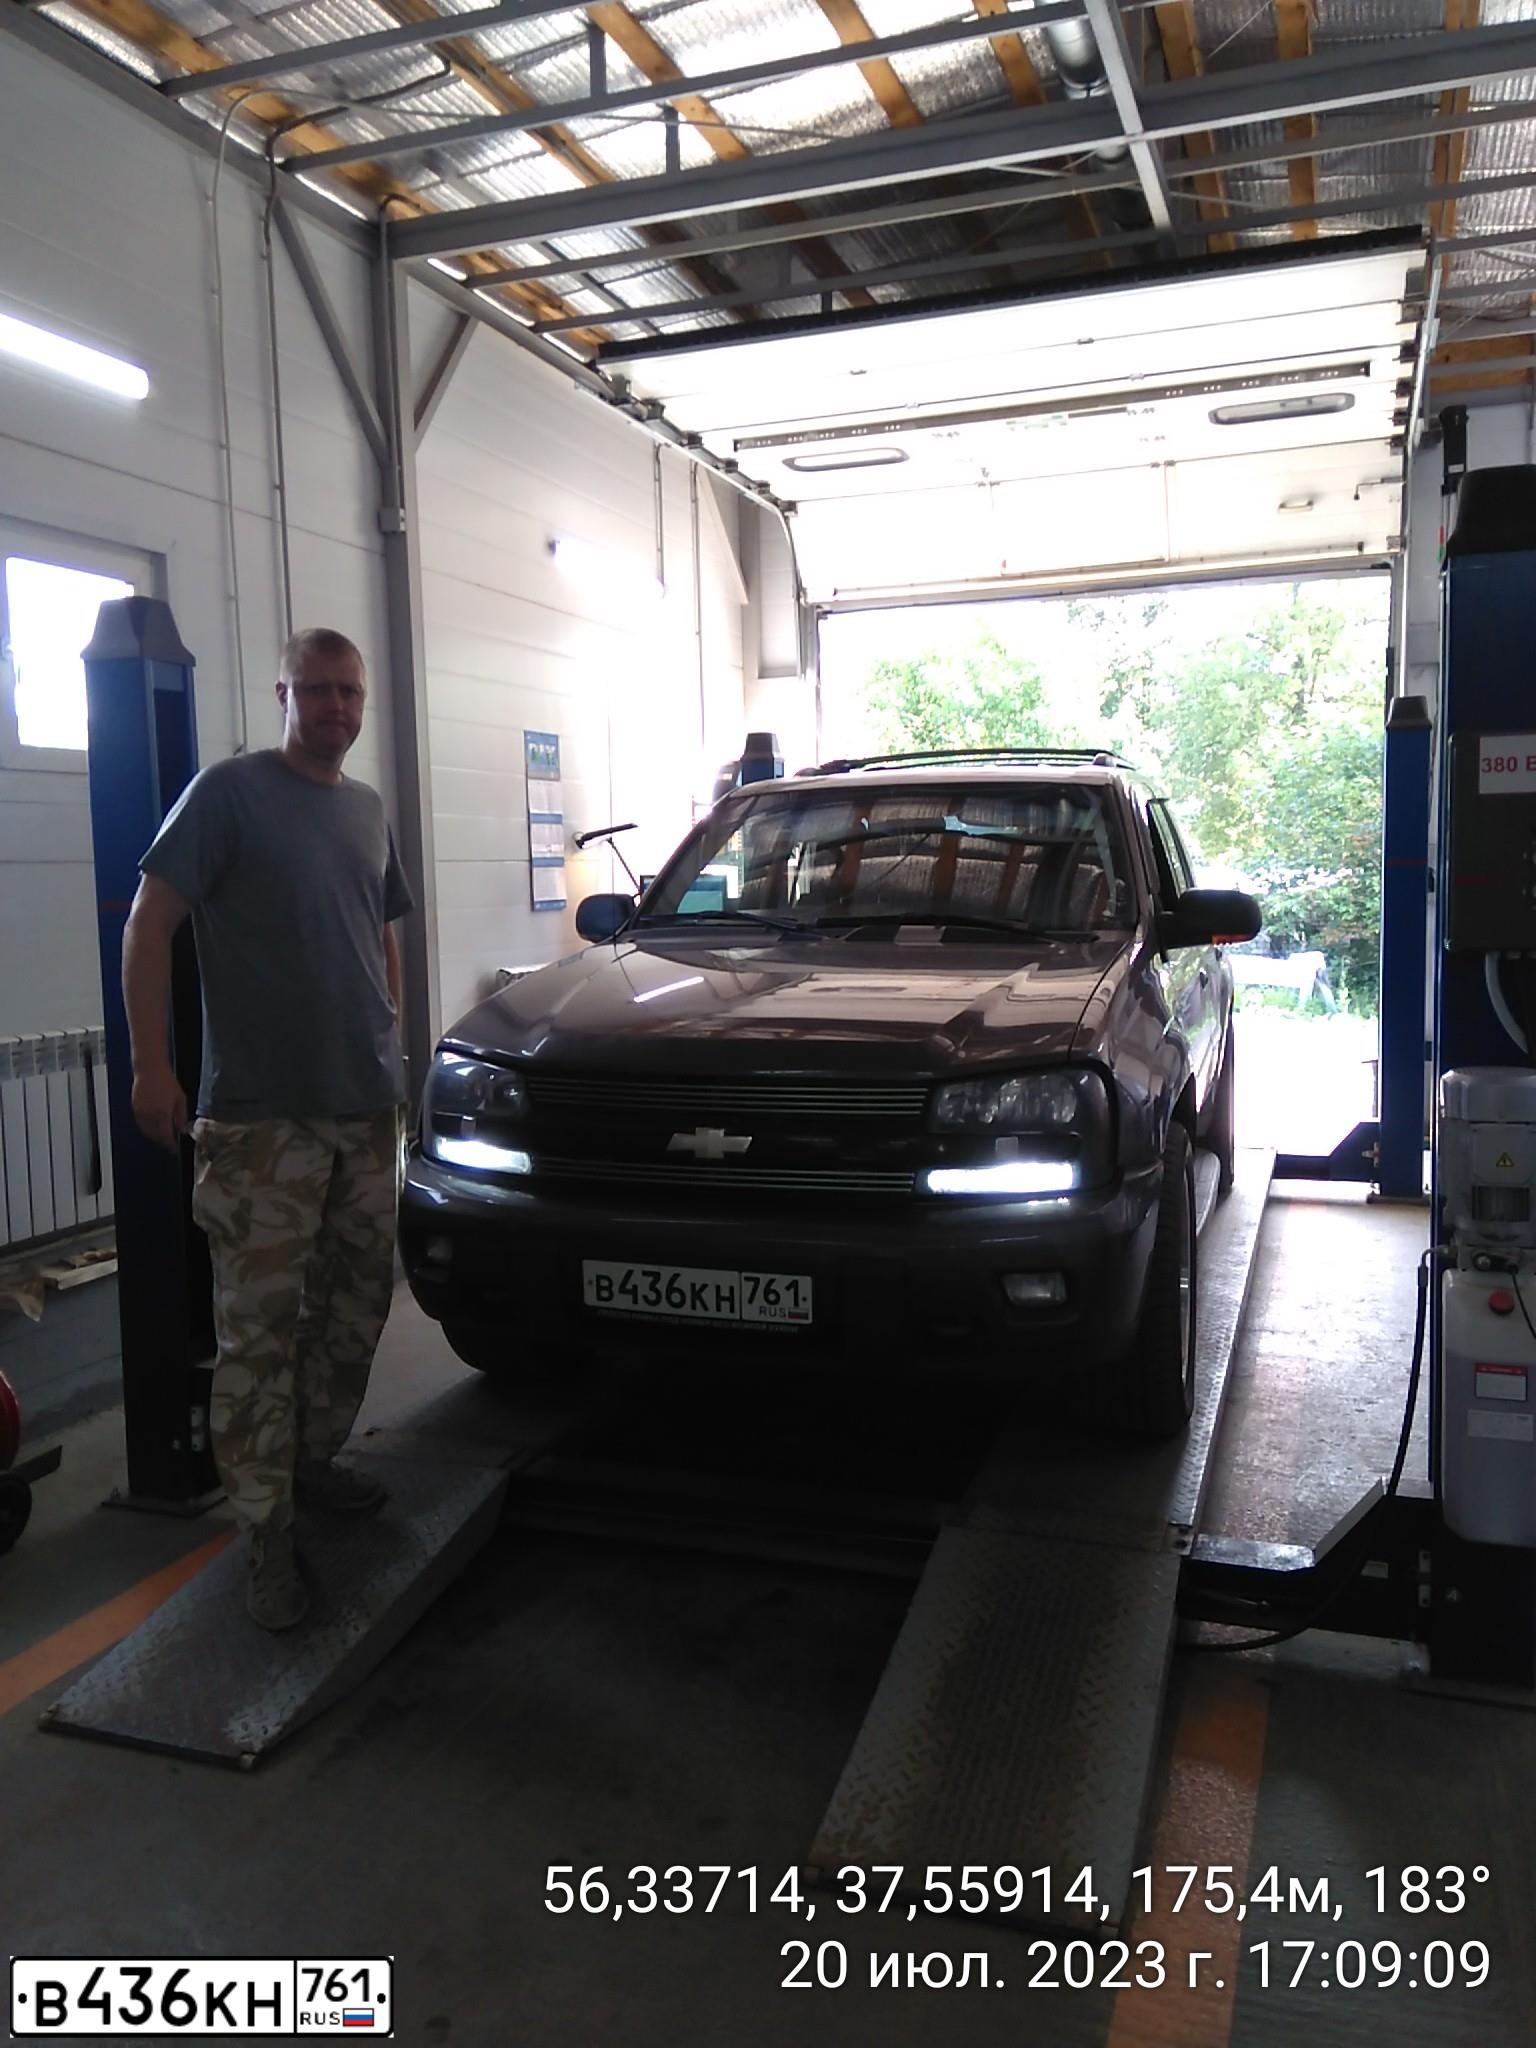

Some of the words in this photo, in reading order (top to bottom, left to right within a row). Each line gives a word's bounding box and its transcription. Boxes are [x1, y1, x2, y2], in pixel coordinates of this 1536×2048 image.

[1481, 756, 1518, 774] 380
[595, 1268, 735, 1314] В436КН
[743, 1276, 799, 1308] 761
[759, 1306, 787, 1319] RUS
